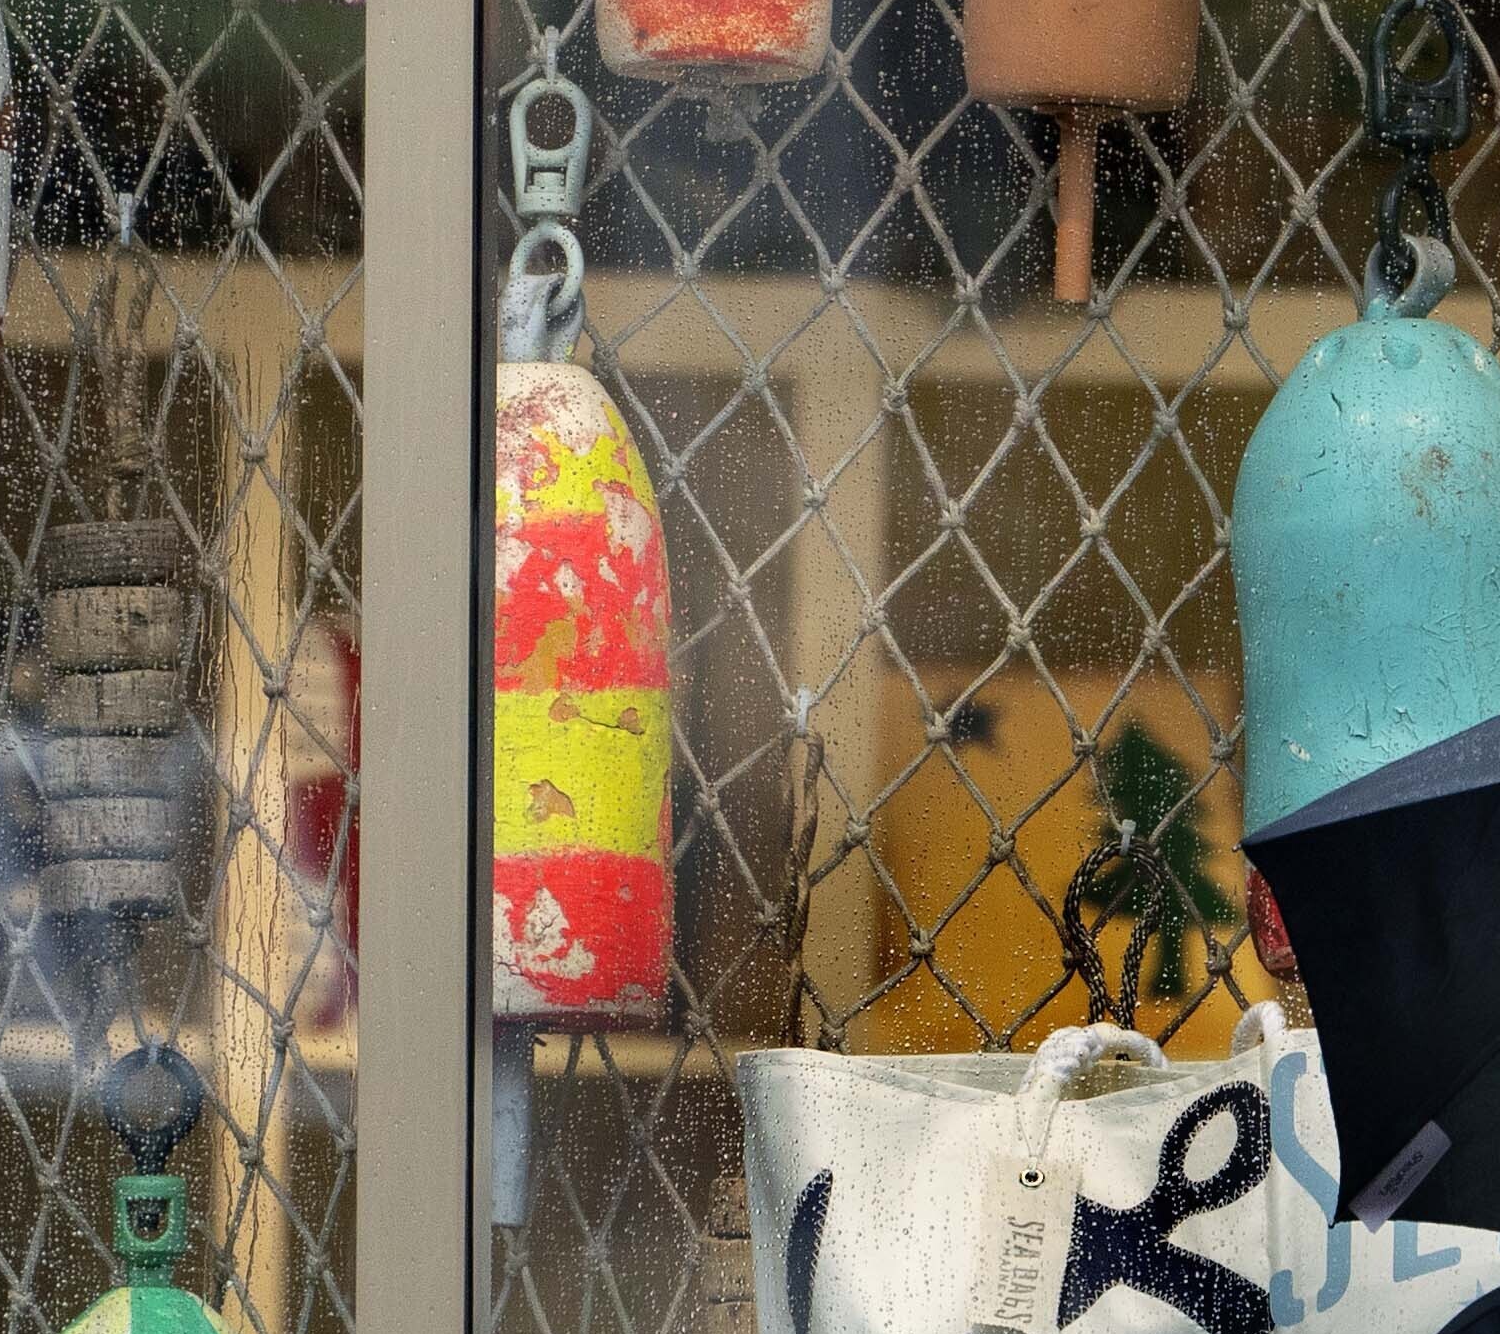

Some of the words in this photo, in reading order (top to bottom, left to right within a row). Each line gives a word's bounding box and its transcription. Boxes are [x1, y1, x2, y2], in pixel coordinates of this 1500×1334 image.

[1007, 1216, 1045, 1259] SEA
[998, 1247, 1012, 1291] MAINE
[994, 1267, 1039, 1324] BAGS
